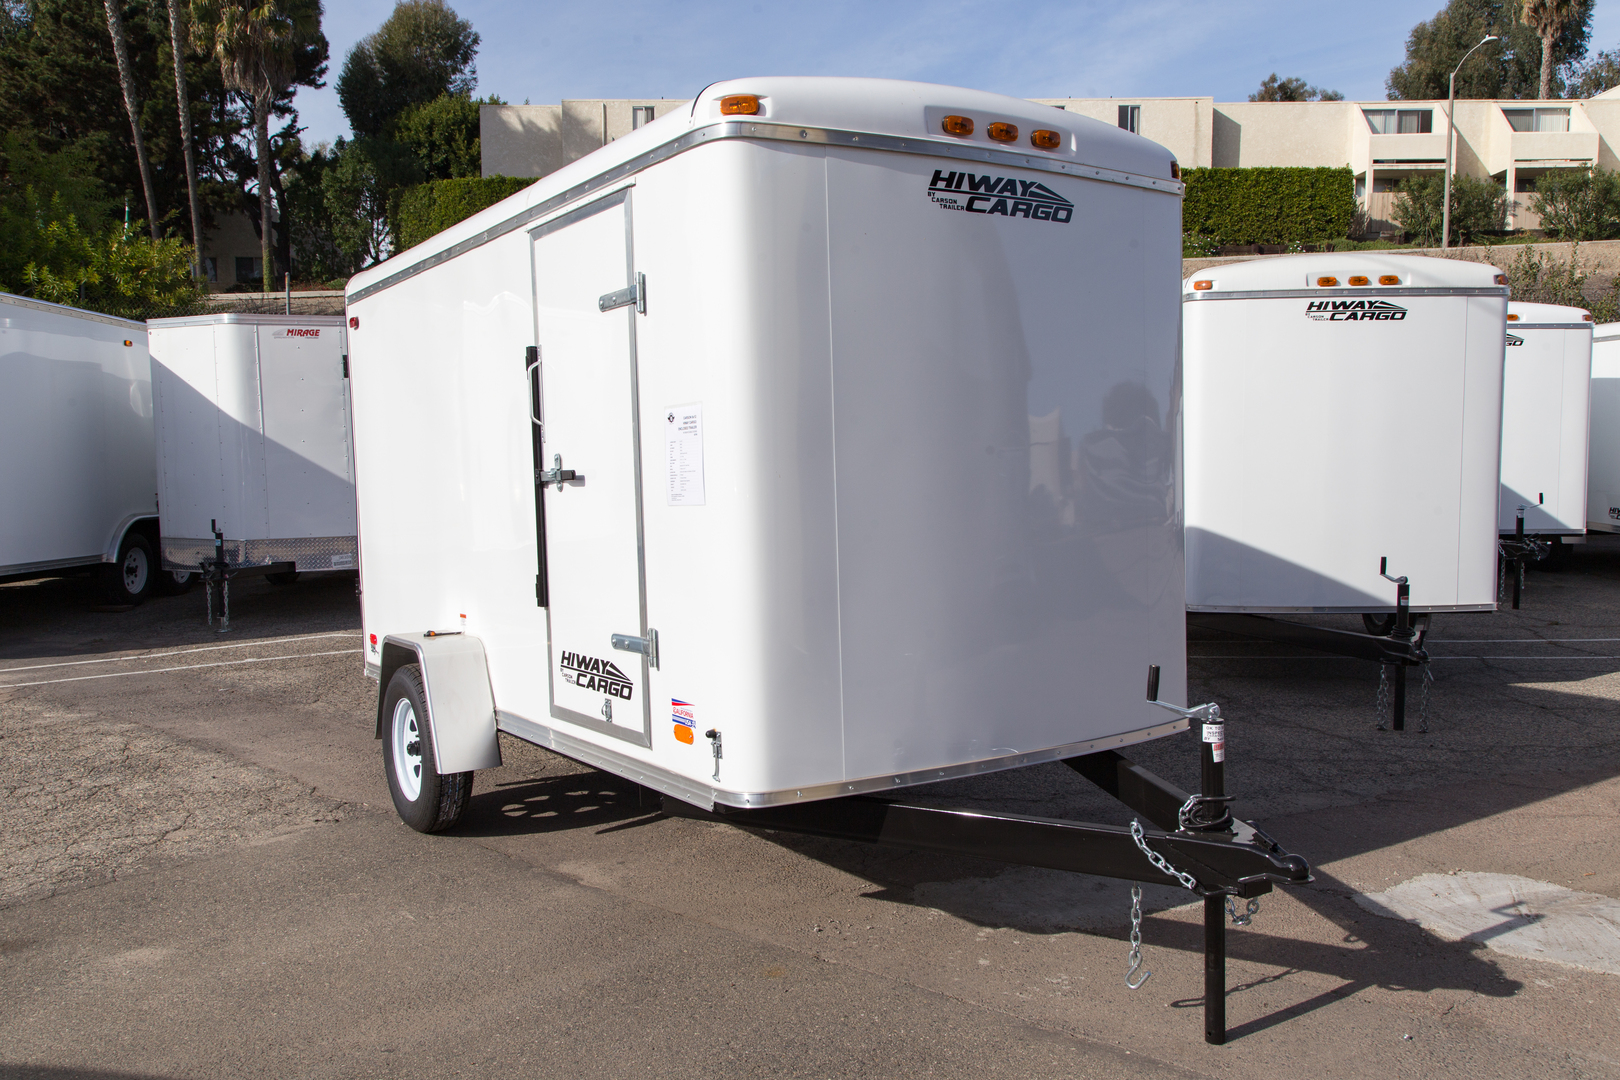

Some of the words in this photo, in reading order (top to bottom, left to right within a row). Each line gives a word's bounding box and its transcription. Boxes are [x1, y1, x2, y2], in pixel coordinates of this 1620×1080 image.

[929, 169, 1037, 197] HIWAY
[931, 197, 958, 205] CARSON
[939, 203, 965, 211] TRAILER
[965, 196, 1073, 223] CARGO
[1307, 300, 1380, 311] HIWAY
[1329, 311, 1408, 321] CARGO
[286, 328, 321, 337] MIRAGE
[561, 650, 611, 675] HIWAY
[576, 672, 633, 701] CARGO
[672, 706, 694, 719] CALIFORNIA
